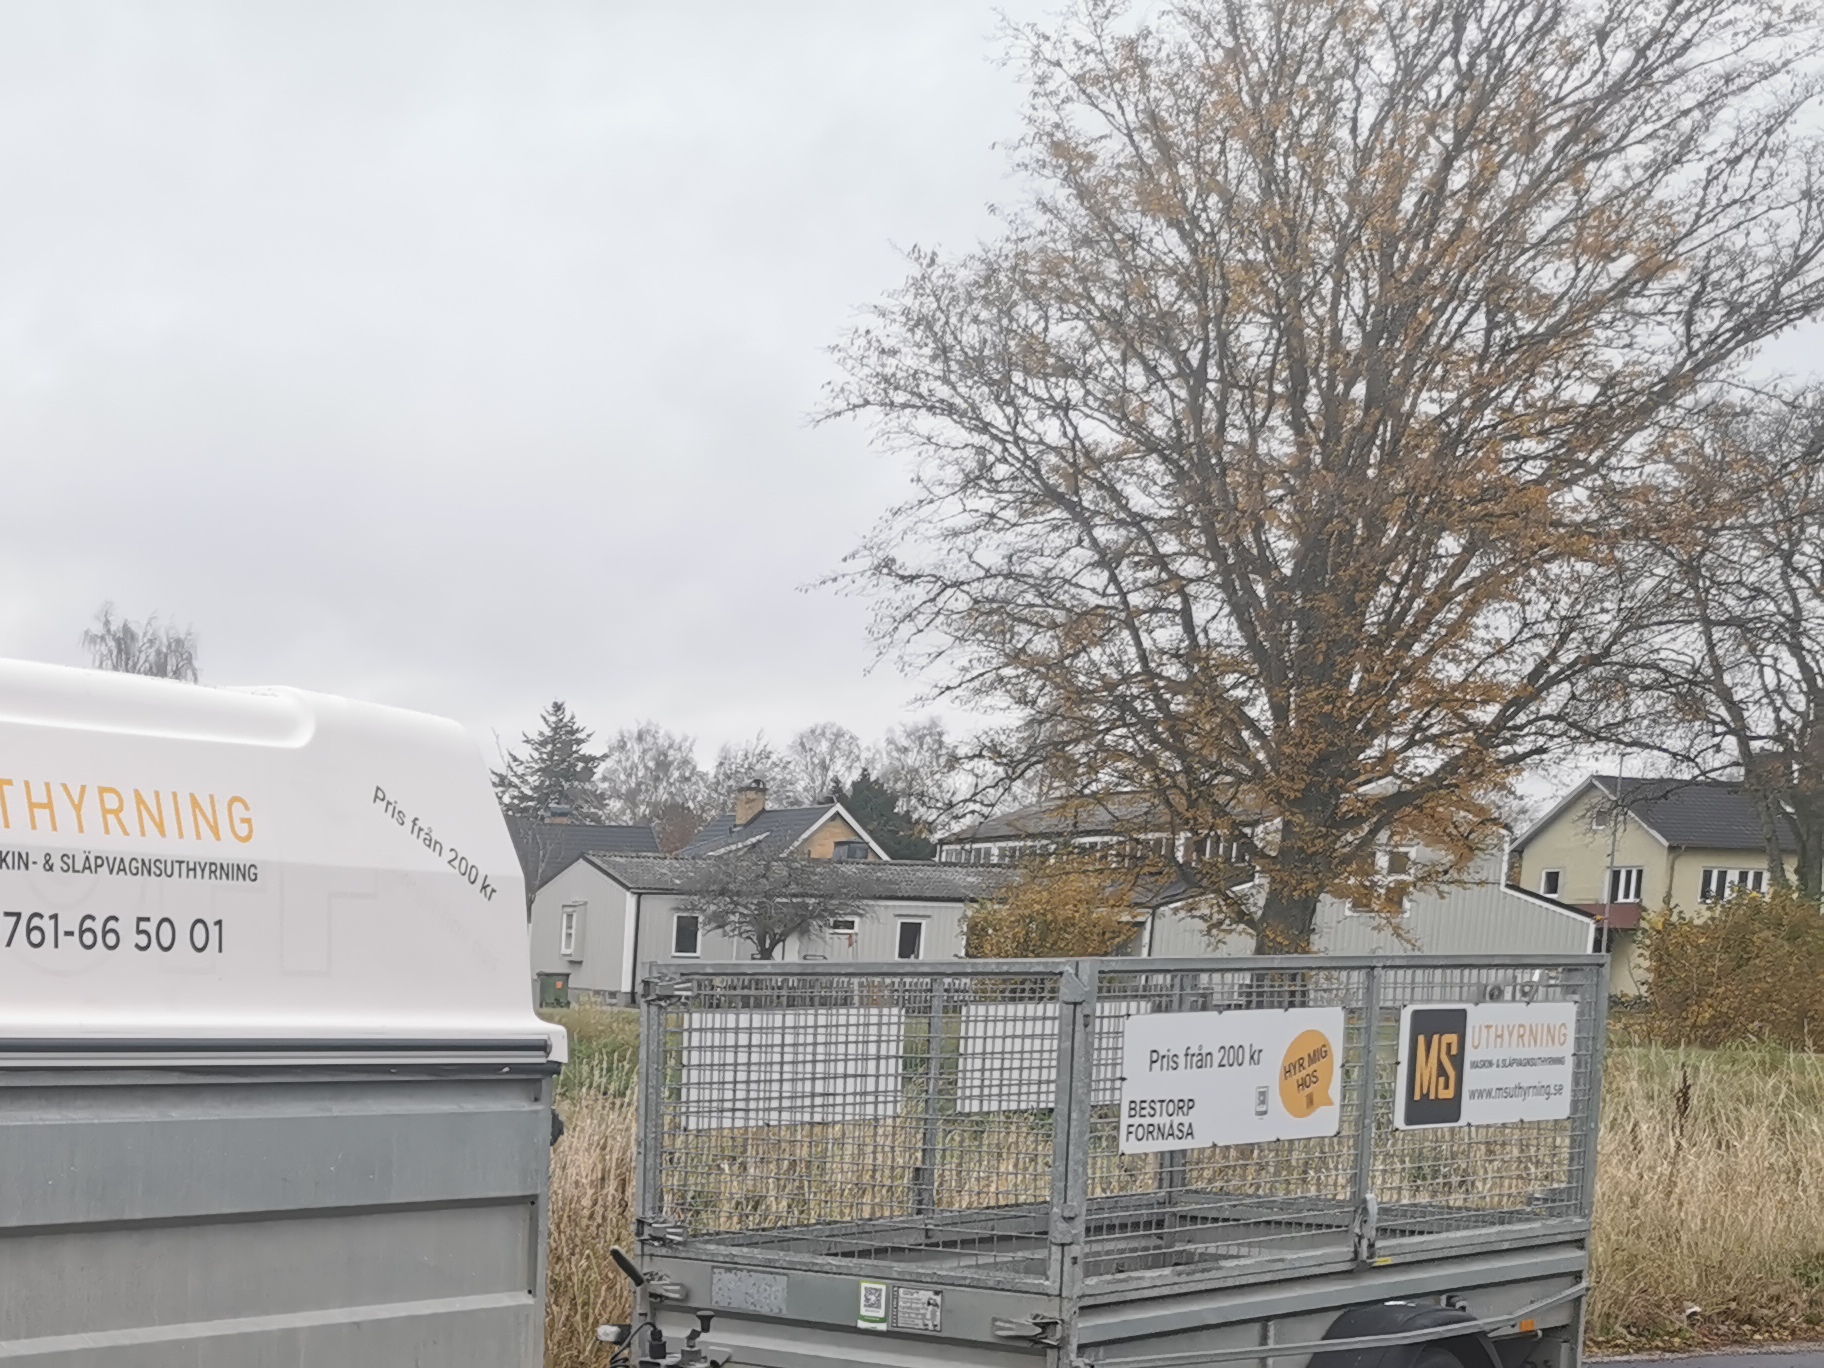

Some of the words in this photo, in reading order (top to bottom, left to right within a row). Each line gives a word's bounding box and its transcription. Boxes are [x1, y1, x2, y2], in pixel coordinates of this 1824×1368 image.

[372, 785, 406, 827] Pris
[409, 817, 444, 858] från
[447, 848, 480, 886] 200
[479, 874, 498, 902] kr
[42, 852, 55, 873] &
[59, 850, 259, 883] SLÄPVAGNSUTHYRNING
[133, 916, 177, 953] 50
[188, 917, 224, 954] 01
[1471, 1022, 1568, 1050] UTHYRNING
[1149, 1048, 1180, 1073] Pris
[1183, 1044, 1214, 1070] från
[1217, 1044, 1245, 1068] 200
[1249, 1043, 1264, 1067] kr
[1283, 1056, 1307, 1081] HYR
[1307, 1043, 1329, 1068] MIG
[1413, 1032, 1459, 1101] MS
[1296, 1068, 1320, 1094] HOS
[1127, 1098, 1196, 1118] BESTORP
[1125, 1119, 1195, 1143] FORNÅSA
